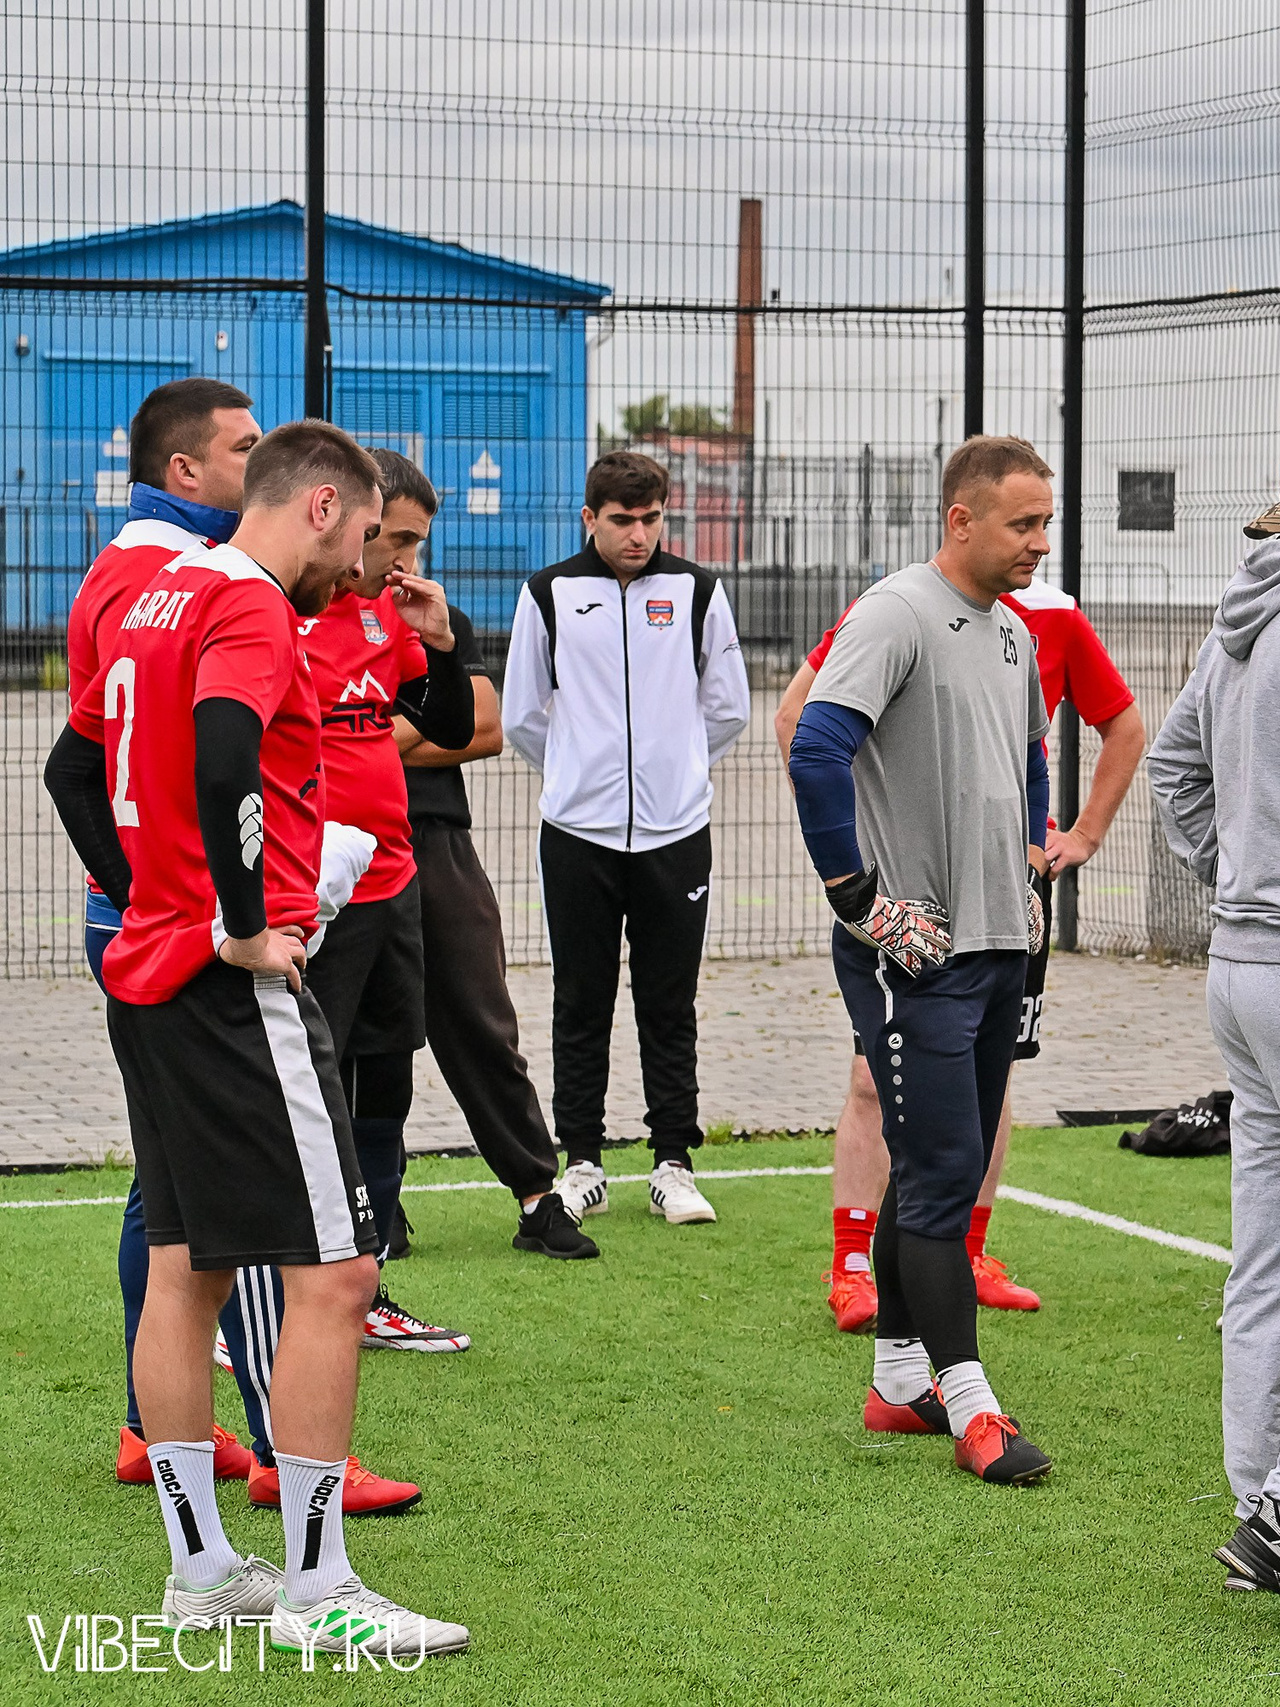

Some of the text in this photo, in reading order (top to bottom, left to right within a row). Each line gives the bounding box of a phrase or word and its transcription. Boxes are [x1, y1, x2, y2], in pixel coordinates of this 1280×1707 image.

[1000, 625, 1018, 666] 25
[104, 656, 140, 827] 2
[156, 1458, 188, 1507] GIOCA
[308, 1474, 340, 1519] GIOCA
